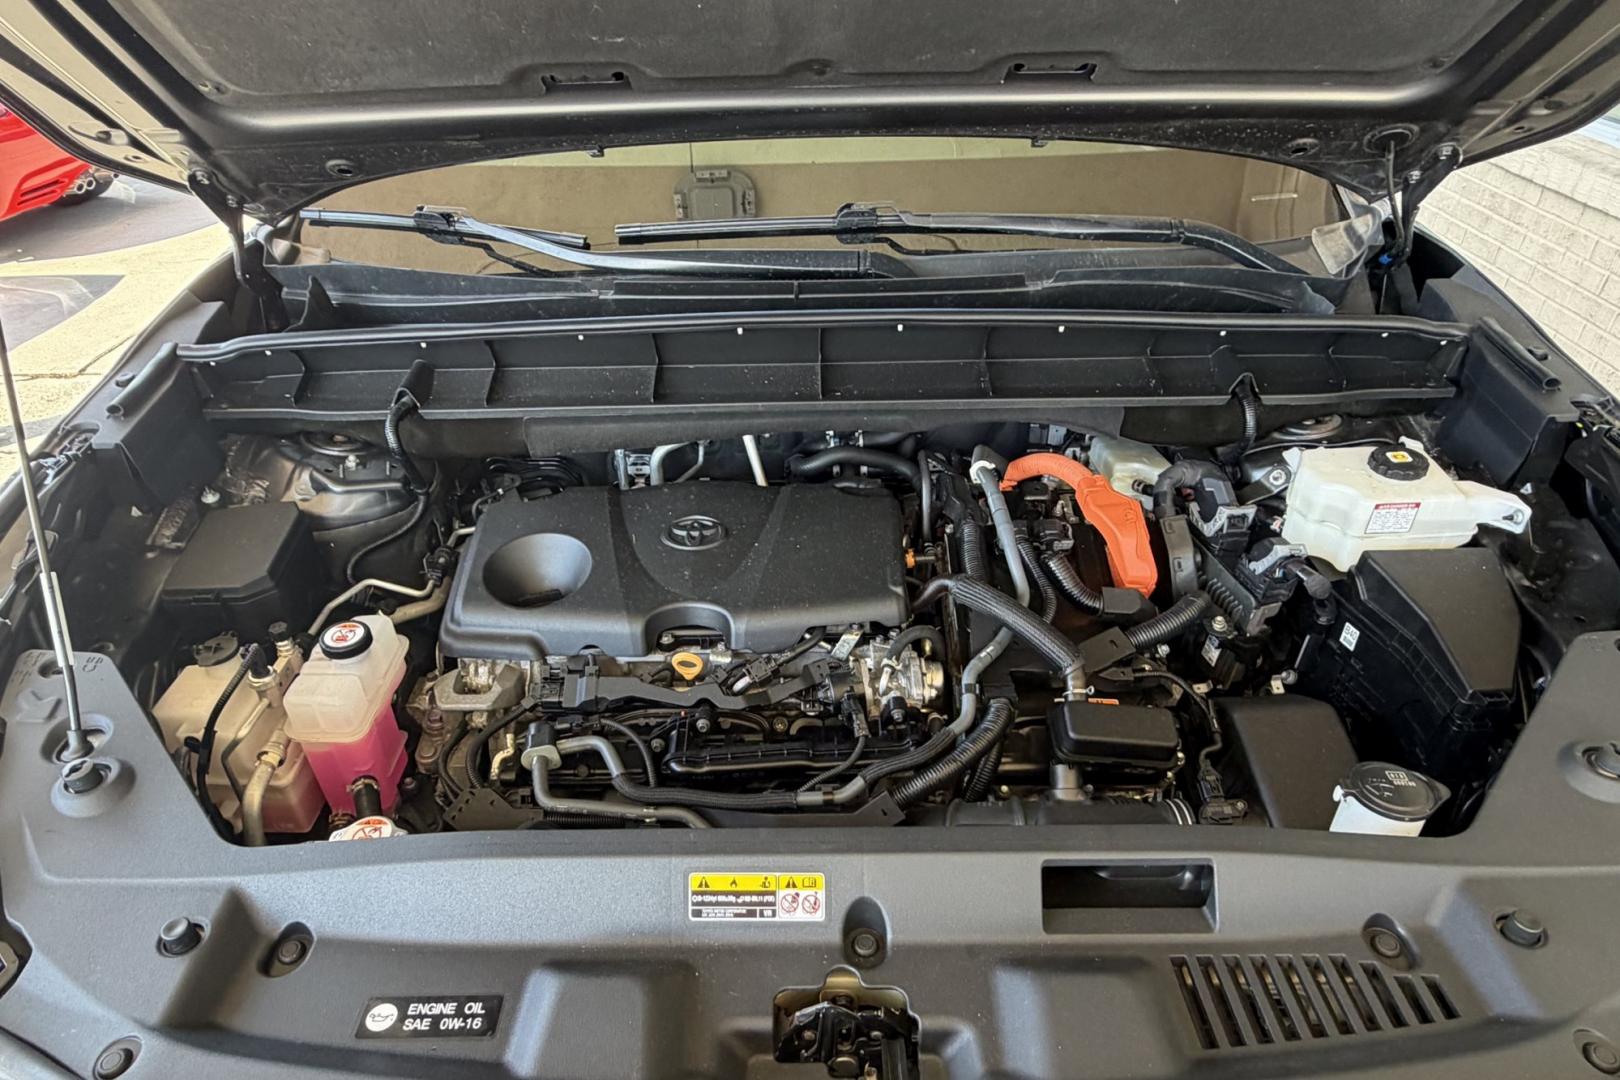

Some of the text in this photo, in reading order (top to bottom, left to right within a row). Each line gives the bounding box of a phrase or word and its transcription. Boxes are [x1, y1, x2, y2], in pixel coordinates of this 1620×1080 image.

[407, 1002, 486, 1015] ENGINE OIL
[402, 1018, 482, 1031] SAE 0W-16
